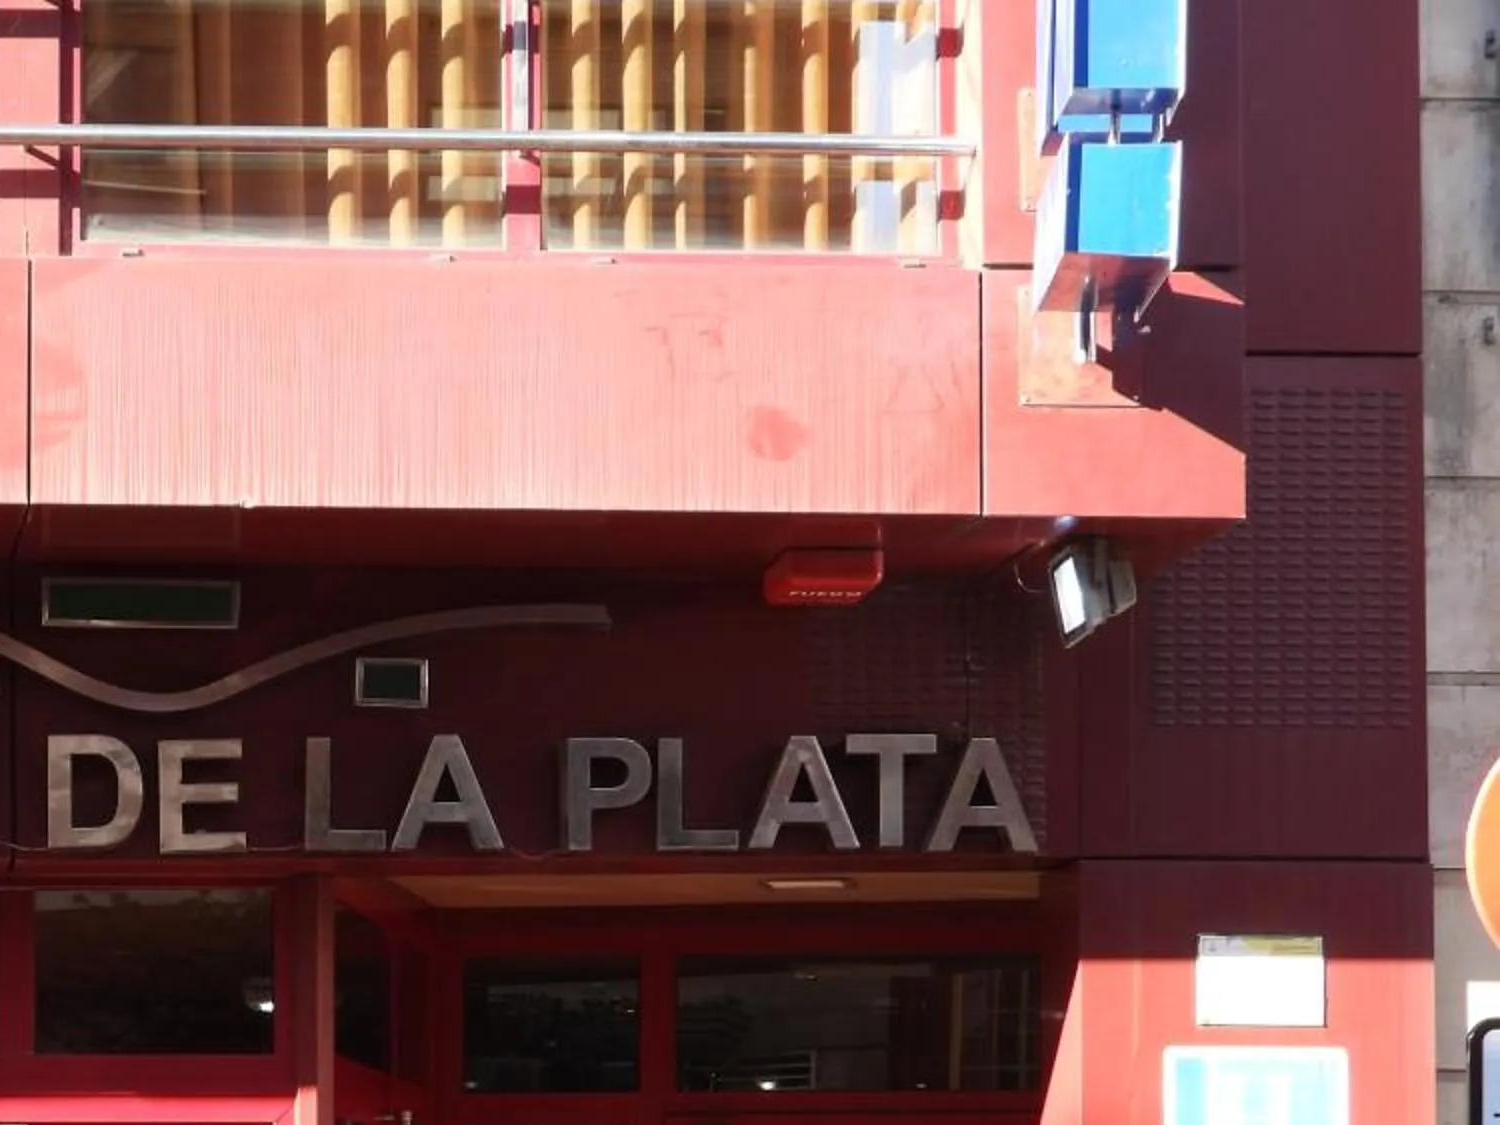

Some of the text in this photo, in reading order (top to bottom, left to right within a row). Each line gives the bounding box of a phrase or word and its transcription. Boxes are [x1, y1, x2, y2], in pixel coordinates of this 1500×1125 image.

[46, 734, 248, 853] DE
[304, 733, 505, 852] LA
[558, 732, 1040, 853] PLATA
